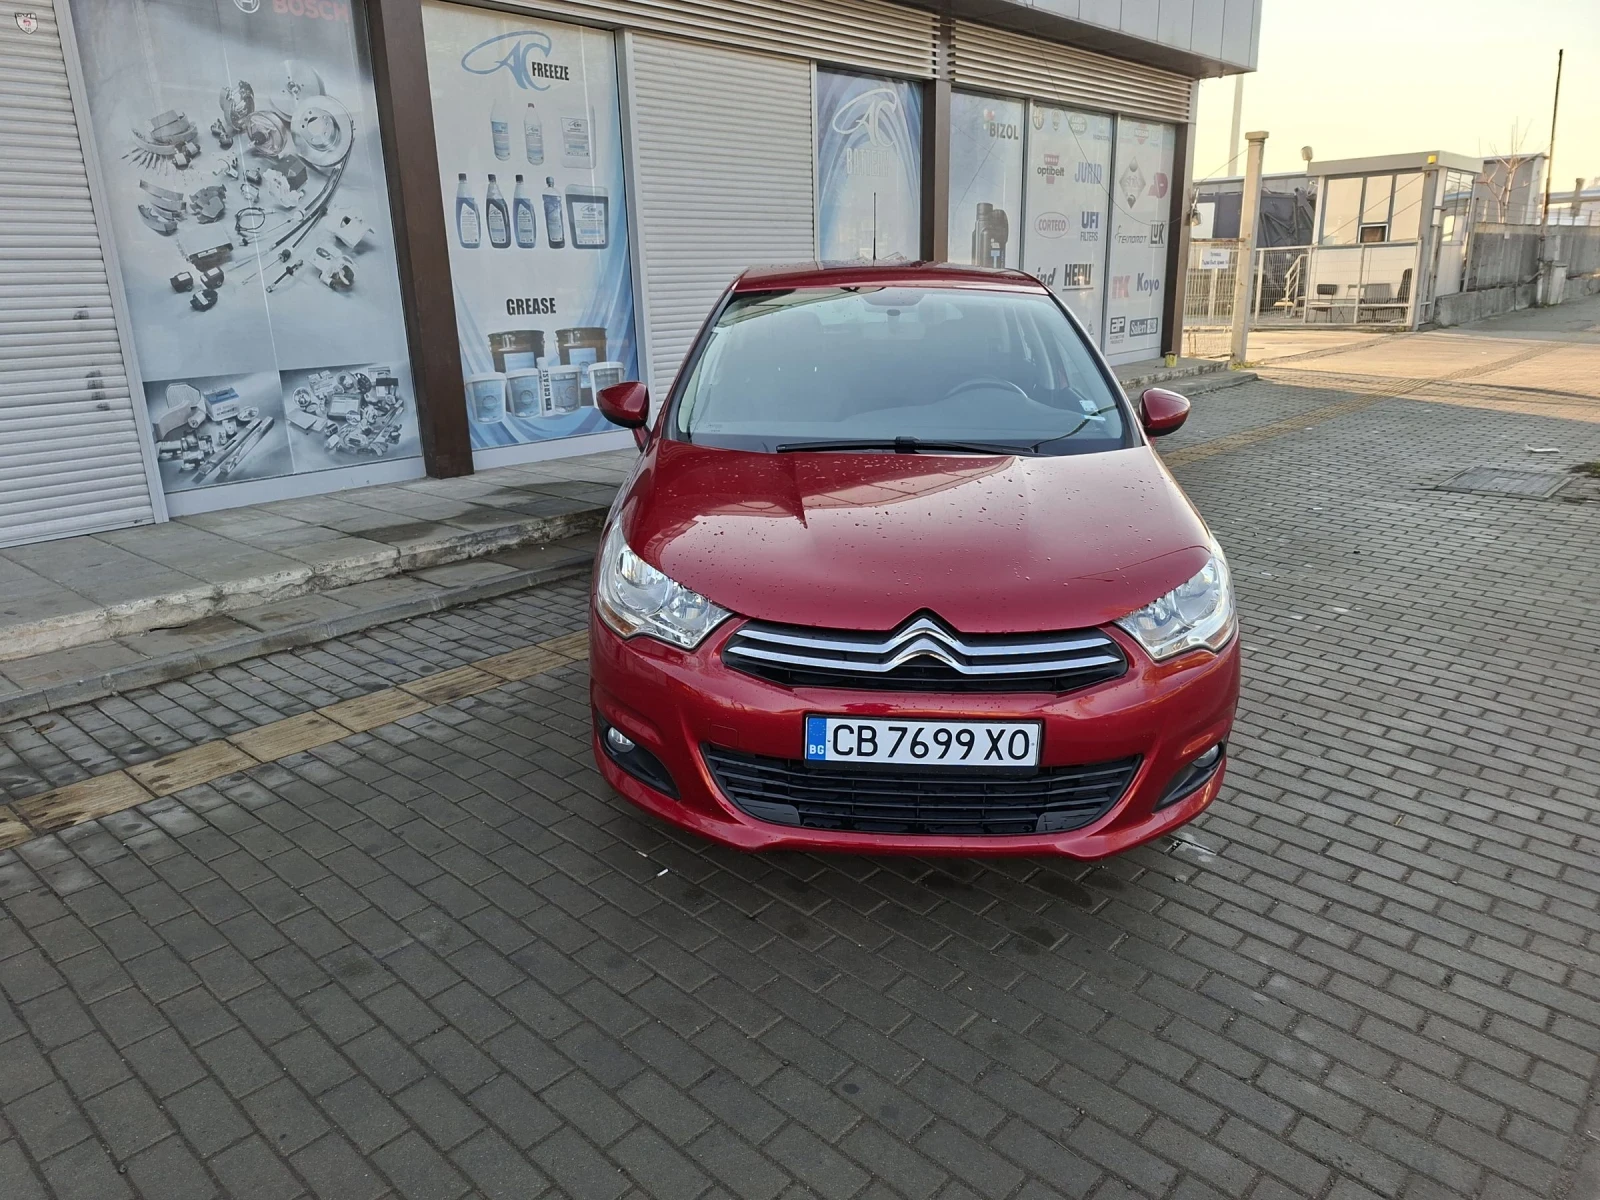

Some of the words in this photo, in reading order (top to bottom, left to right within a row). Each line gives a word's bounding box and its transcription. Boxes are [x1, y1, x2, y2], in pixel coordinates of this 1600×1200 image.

[272, 0, 349, 22] BOSCH
[531, 61, 570, 81] FREEEZE
[989, 121, 1019, 140] BIZOL
[1036, 165, 1065, 177] optibelt
[1074, 162, 1103, 185] JURID
[1038, 220, 1067, 232] CORTECO
[1081, 211, 1099, 229] UFI
[1080, 231, 1099, 242] FILTERS
[1136, 272, 1160, 297] Koyo
[506, 297, 557, 316] GREASE
[809, 744, 825, 755] BG
[832, 724, 878, 757] CB
[887, 726, 976, 760] 7699
[983, 728, 1030, 761] XO
